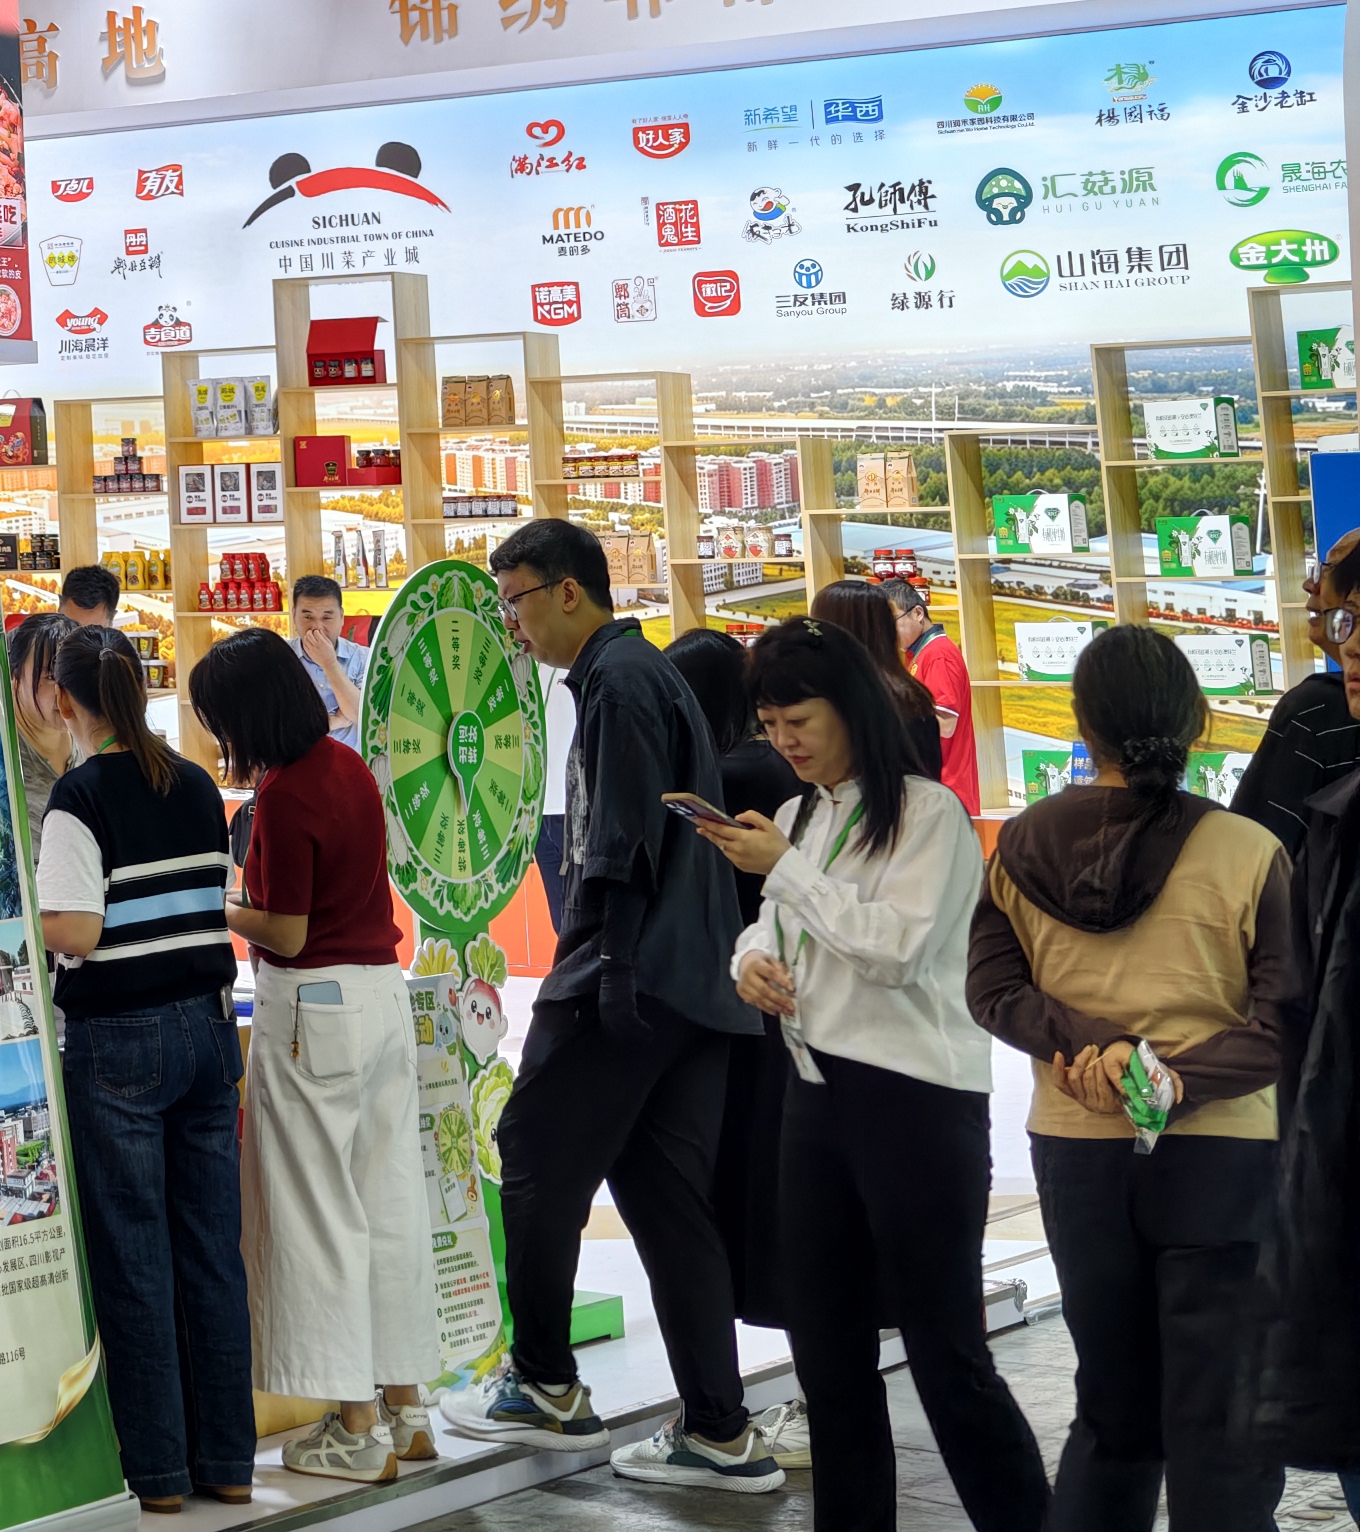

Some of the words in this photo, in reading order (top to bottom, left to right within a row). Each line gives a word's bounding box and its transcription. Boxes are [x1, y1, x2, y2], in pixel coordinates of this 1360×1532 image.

[743, 104, 799, 127] 新希望
[825, 99, 881, 120] 华西
[638, 128, 686, 148] 好人家
[747, 129, 886, 153] 新鲜一代的选择
[509, 151, 588, 178] 满江红
[138, 169, 182, 197] 有友
[1041, 166, 1158, 201] 汇菇源
[1282, 182, 1332, 194] SHENGHAI
[843, 178, 937, 214] 孔師傅
[1042, 203, 1072, 215] HUI
[1082, 200, 1102, 212] GU
[1113, 197, 1160, 209] YUAN
[312, 211, 382, 230] SICHUAN
[845, 217, 938, 234] KongShiFu
[269, 238, 305, 250] CUISINE
[307, 234, 361, 248] INDUSTRIAL
[363, 232, 389, 244] TOWN
[391, 231, 403, 241] OF
[405, 228, 434, 240] CHINA
[542, 230, 605, 246] MATEDO
[278, 245, 420, 274] 中国川菜产业城
[1056, 243, 1190, 279] 山海集团
[1237, 238, 1331, 266] 金大州
[1058, 280, 1100, 292] SHAN
[1103, 277, 1131, 290] HAI
[1134, 275, 1191, 287] GROUP
[534, 285, 578, 304] 诺高美
[775, 291, 846, 309] 三友集团
[890, 289, 956, 311] 绿源行
[537, 303, 578, 320] NGM
[776, 308, 813, 319] Sanyou
[816, 306, 847, 318] Group
[145, 326, 191, 343] 吉食道
[58, 337, 109, 354] 川海晨洋
